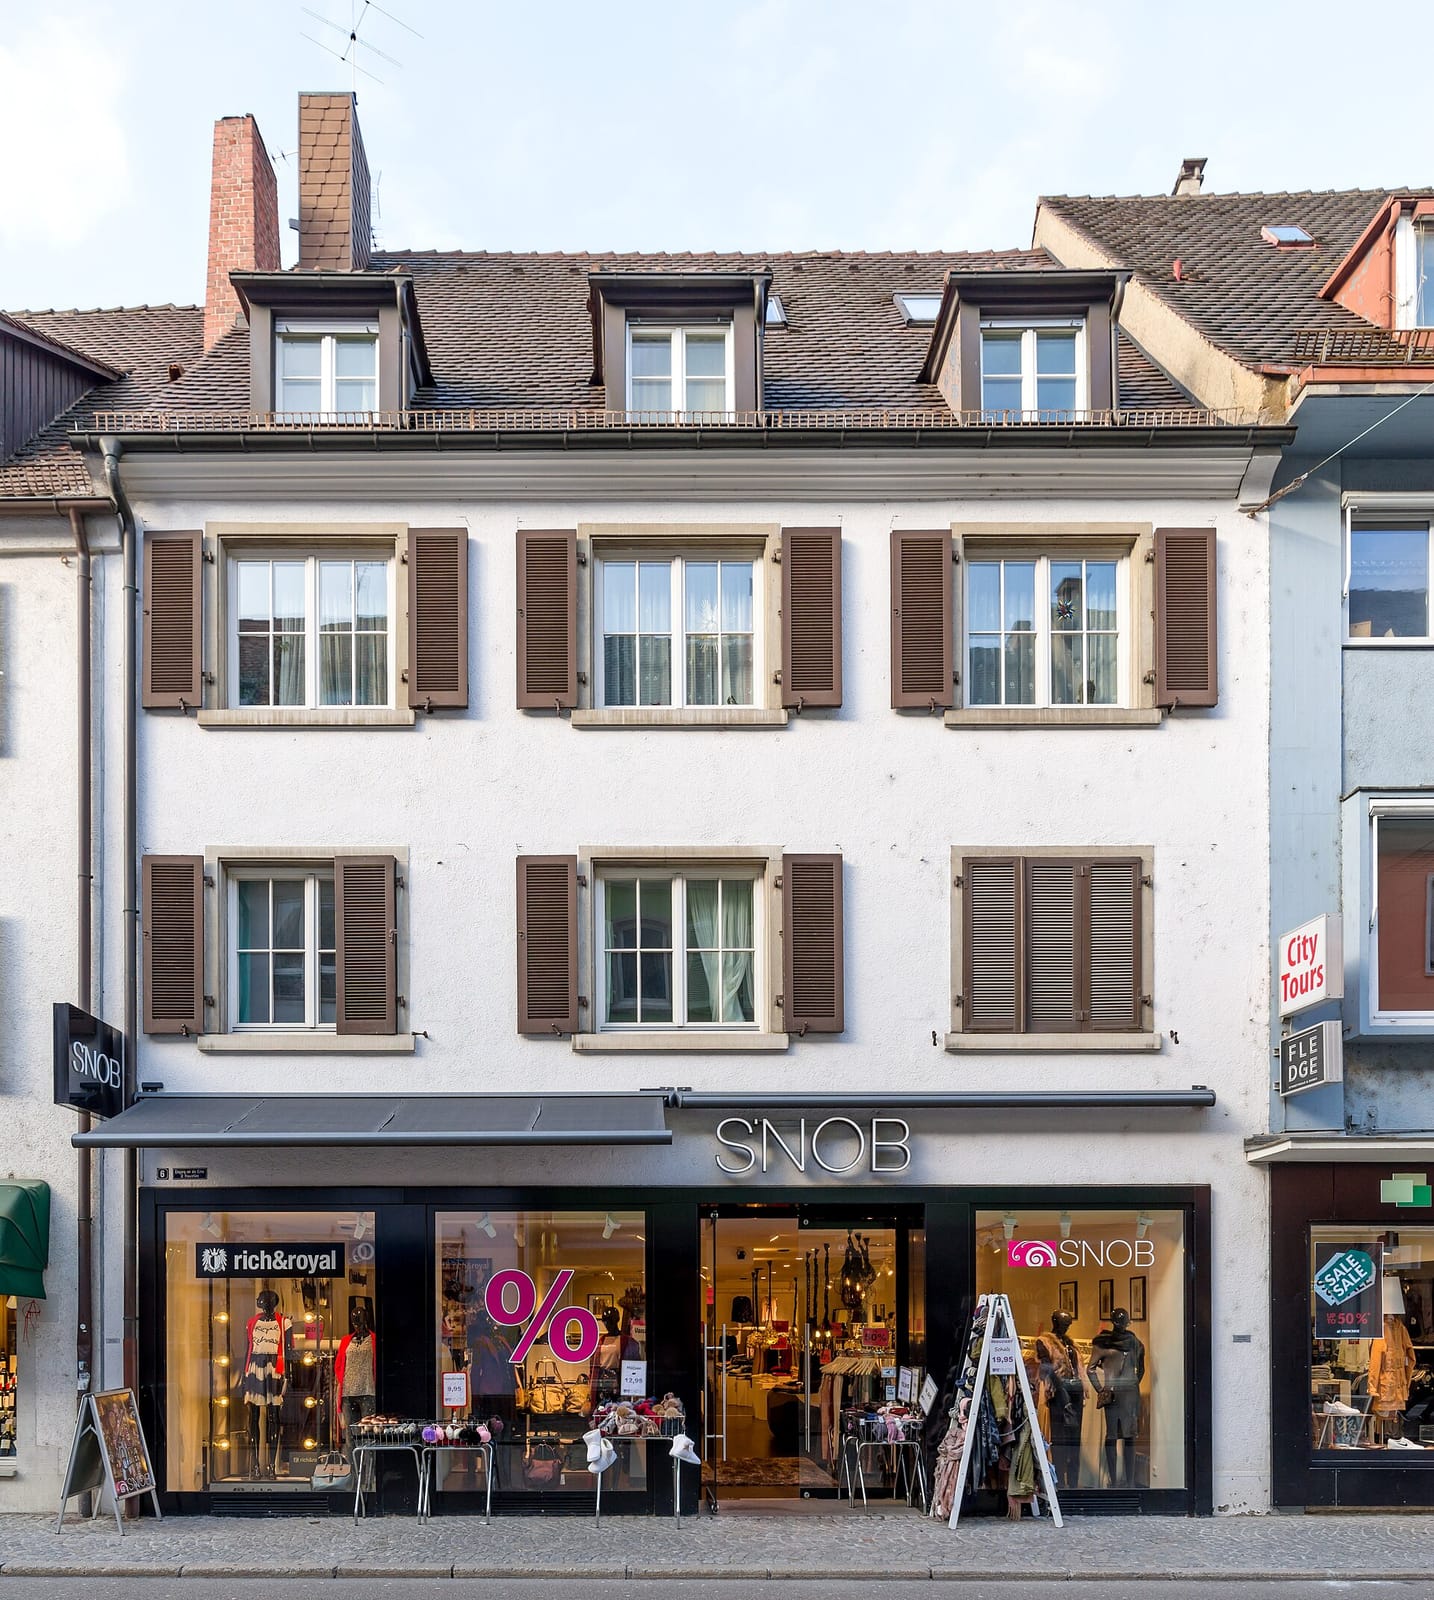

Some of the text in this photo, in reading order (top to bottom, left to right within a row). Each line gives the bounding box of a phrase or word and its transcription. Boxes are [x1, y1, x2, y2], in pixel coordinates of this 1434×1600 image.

[1287, 933, 1318, 967] City
[1281, 964, 1324, 1002] Tours
[1288, 1036, 1318, 1062] FLE
[1288, 1056, 1318, 1082] DGE
[160, 1169, 166, 1178] 6
[233, 1250, 337, 1274] rich&royal
[1324, 1254, 1359, 1286] SALE
[1333, 1265, 1368, 1297] SALE
[992, 1356, 1014, 1364] 19,95
